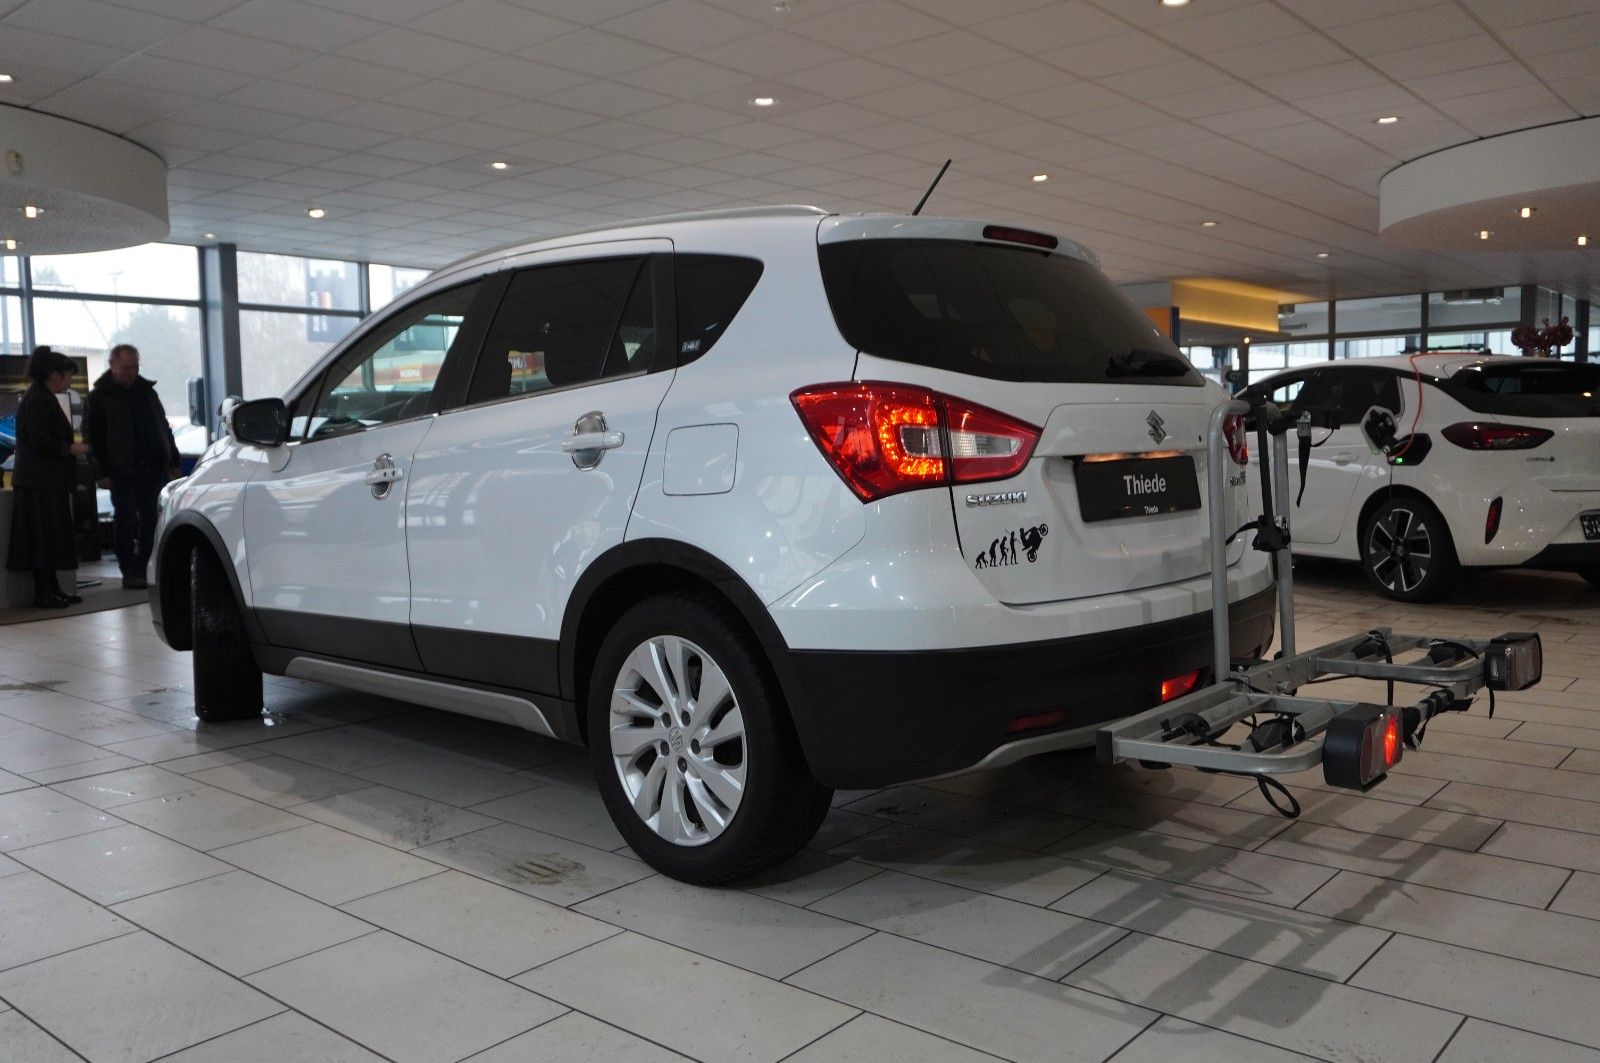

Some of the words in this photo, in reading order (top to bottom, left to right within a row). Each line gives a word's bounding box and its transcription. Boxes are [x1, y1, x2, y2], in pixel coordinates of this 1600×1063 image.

[1123, 473, 1167, 495] Thiede
[966, 491, 1027, 507] SUZUKI
[1144, 505, 1159, 513] Thiede
